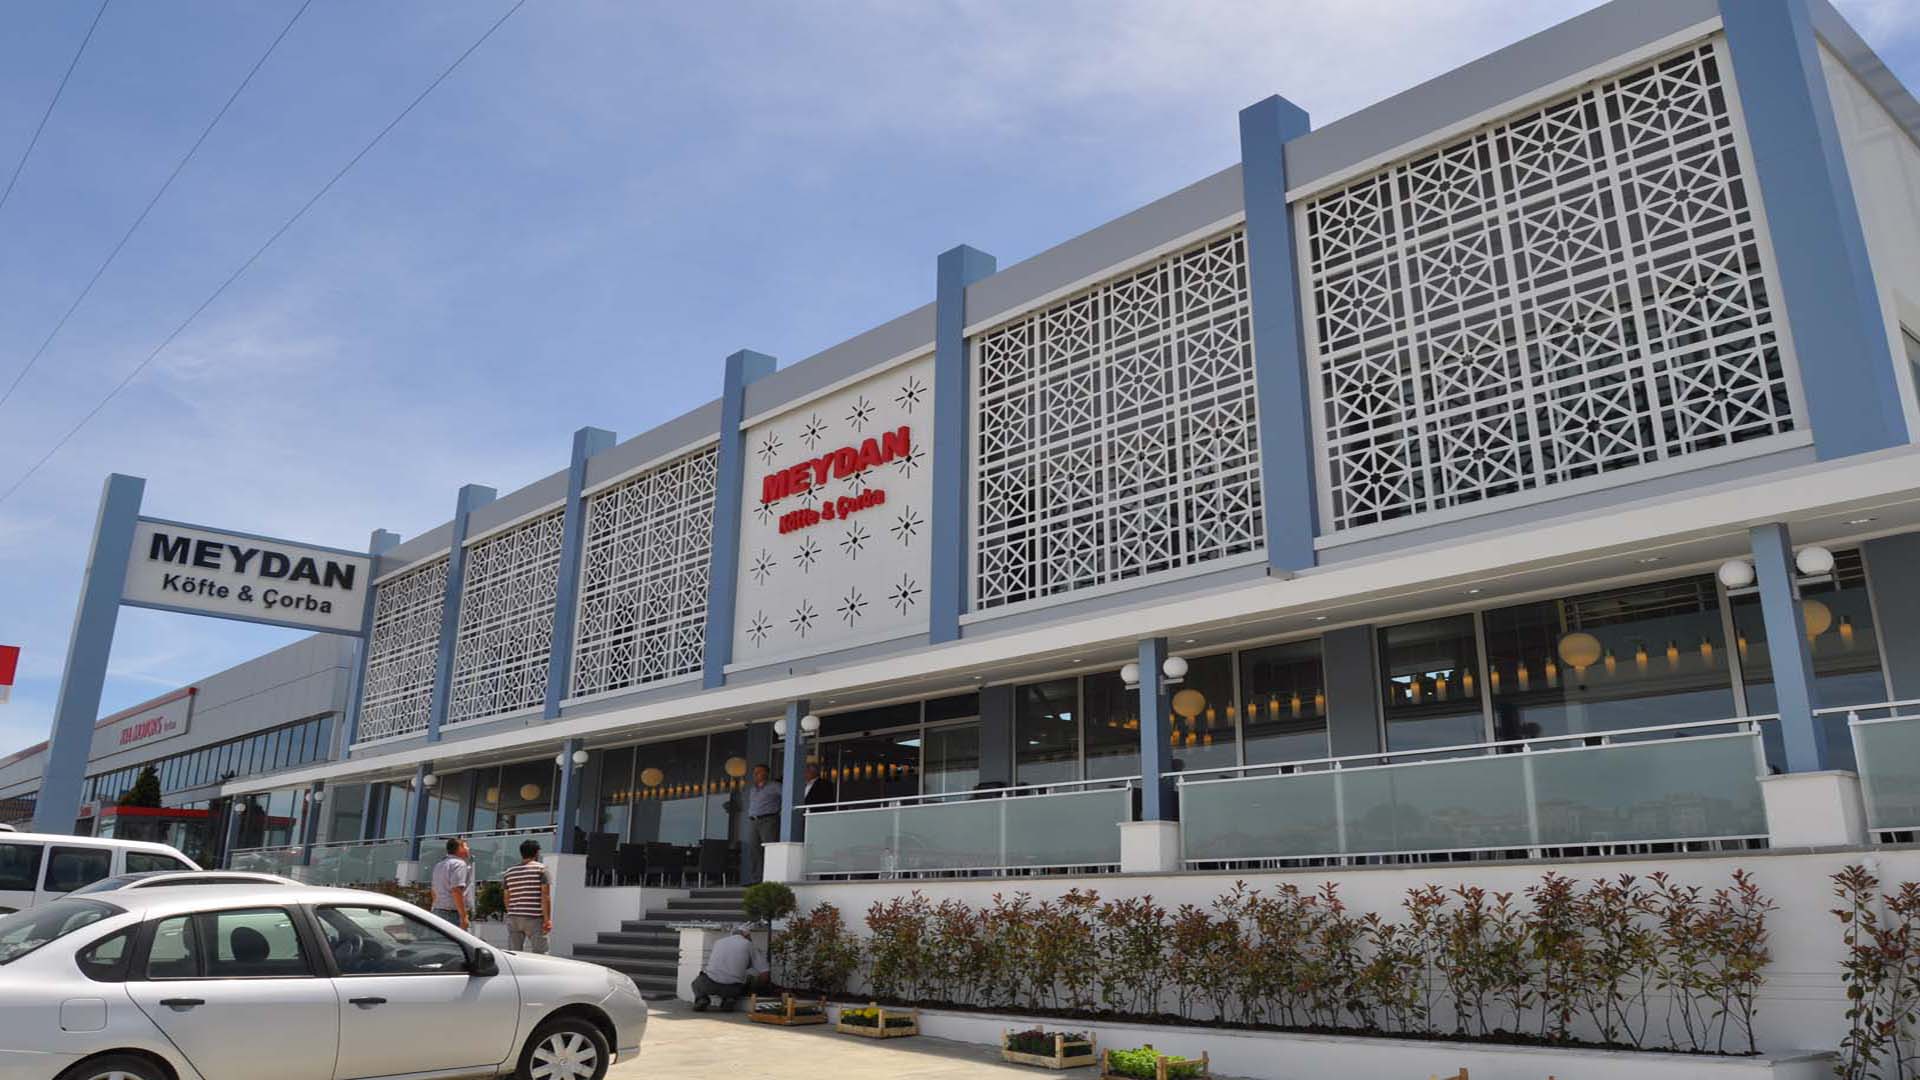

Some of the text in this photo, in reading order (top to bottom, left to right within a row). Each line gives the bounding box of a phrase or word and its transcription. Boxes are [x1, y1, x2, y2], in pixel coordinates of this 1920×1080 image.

[760, 426, 910, 503] MEYDAN
[150, 532, 356, 591] MEYDAN
[162, 573, 332, 613] Köfte & Çorba
